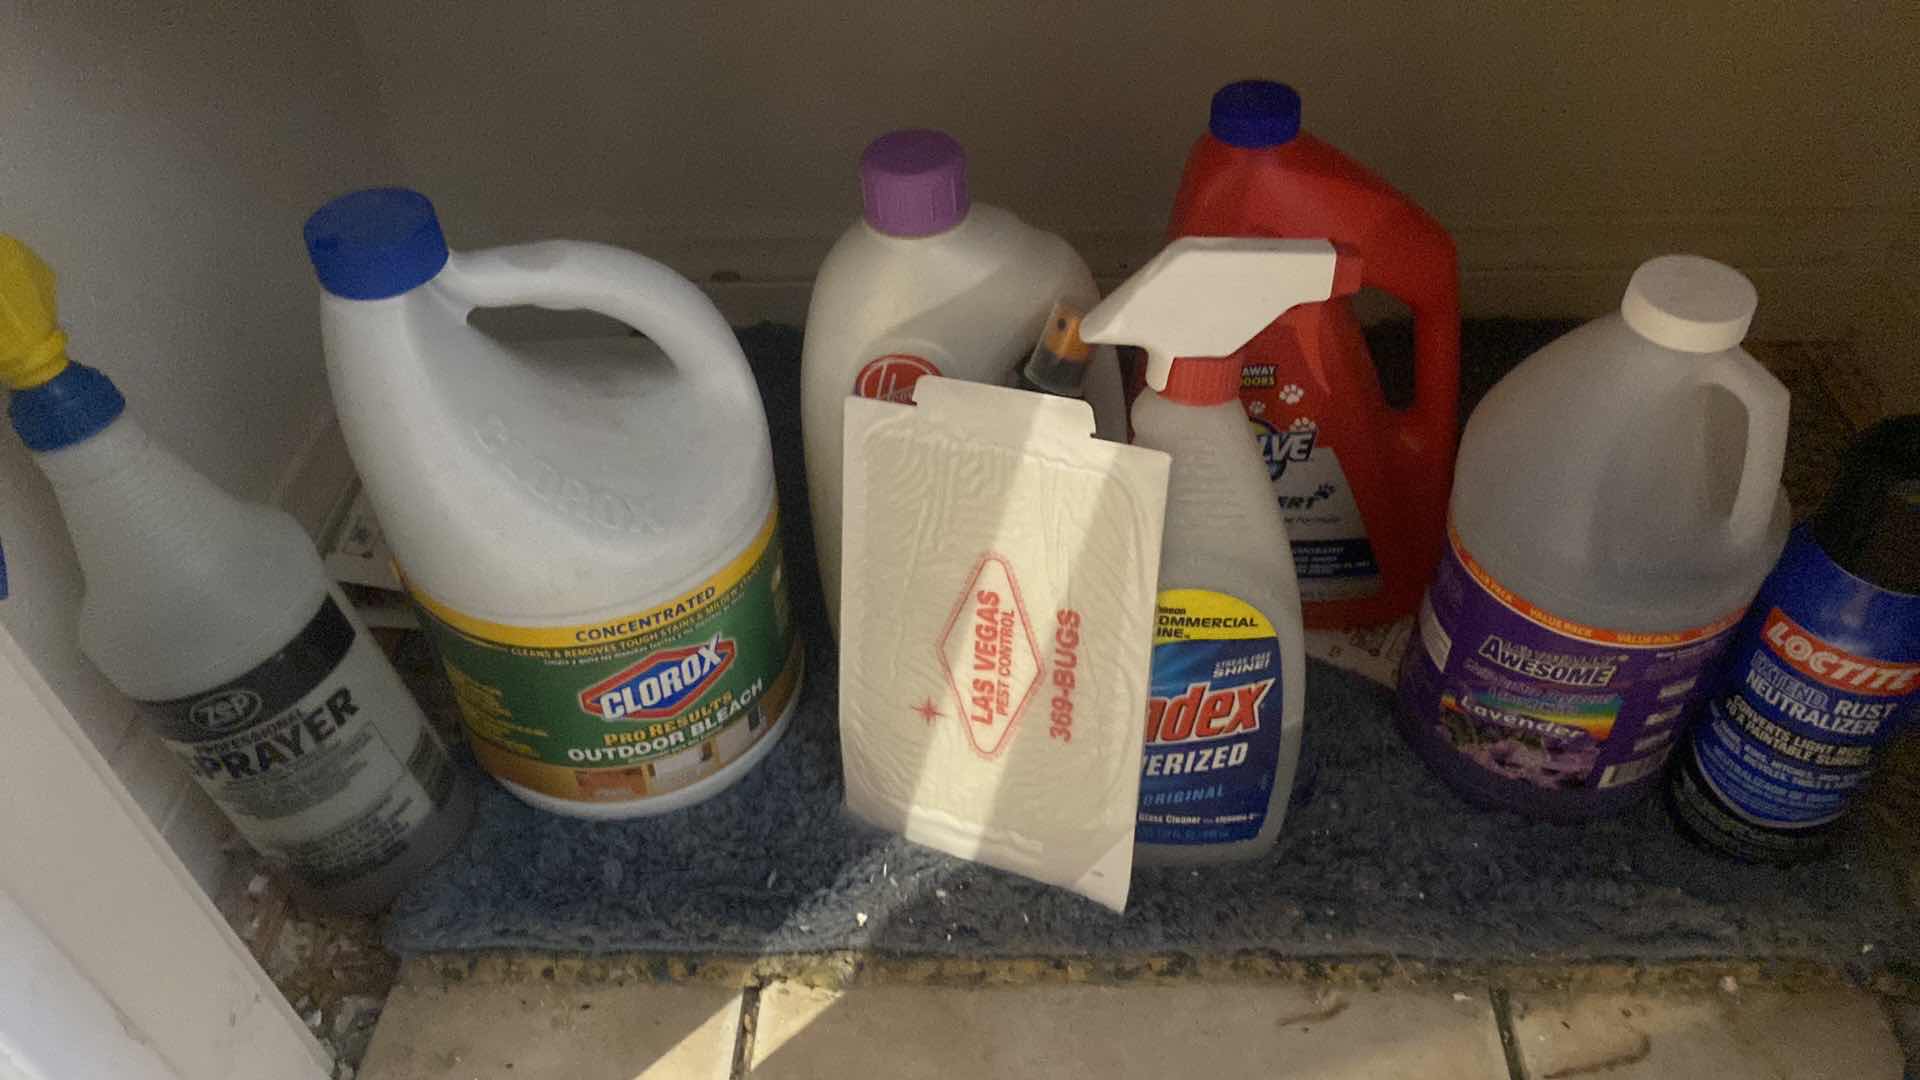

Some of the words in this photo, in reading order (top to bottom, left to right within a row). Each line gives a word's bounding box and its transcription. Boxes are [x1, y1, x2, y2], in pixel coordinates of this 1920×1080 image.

[576, 586, 715, 642] CONCENTRATED
[974, 590, 1000, 671] VEGAS
[1158, 615, 1258, 628] OMMERCIAL
[564, 645, 617, 659] REMOVES
[620, 634, 656, 650] TOUGH
[998, 609, 1015, 677] CONTROL
[1212, 659, 1272, 678] SHINE!
[1481, 636, 1612, 688] AWESOME
[1766, 621, 1919, 690] LOCTITE
[599, 632, 723, 722] CLOROX
[971, 677, 995, 726] LAS
[996, 679, 1010, 717] PEST
[1049, 607, 1081, 744] 369-BUGS
[1745, 669, 1882, 736] NEUTRALIZER
[567, 729, 686, 763] OUTDOOR
[690, 677, 764, 738] BLEACH
[603, 729, 646, 747] PRO
[649, 690, 733, 737] RESULTS
[1145, 680, 1273, 746] dex
[1460, 695, 1585, 739] Lavender
[1833, 699, 1898, 720] RUST
[1144, 742, 1249, 776] ERIZED
[1143, 784, 1224, 807] ORIGINAL
